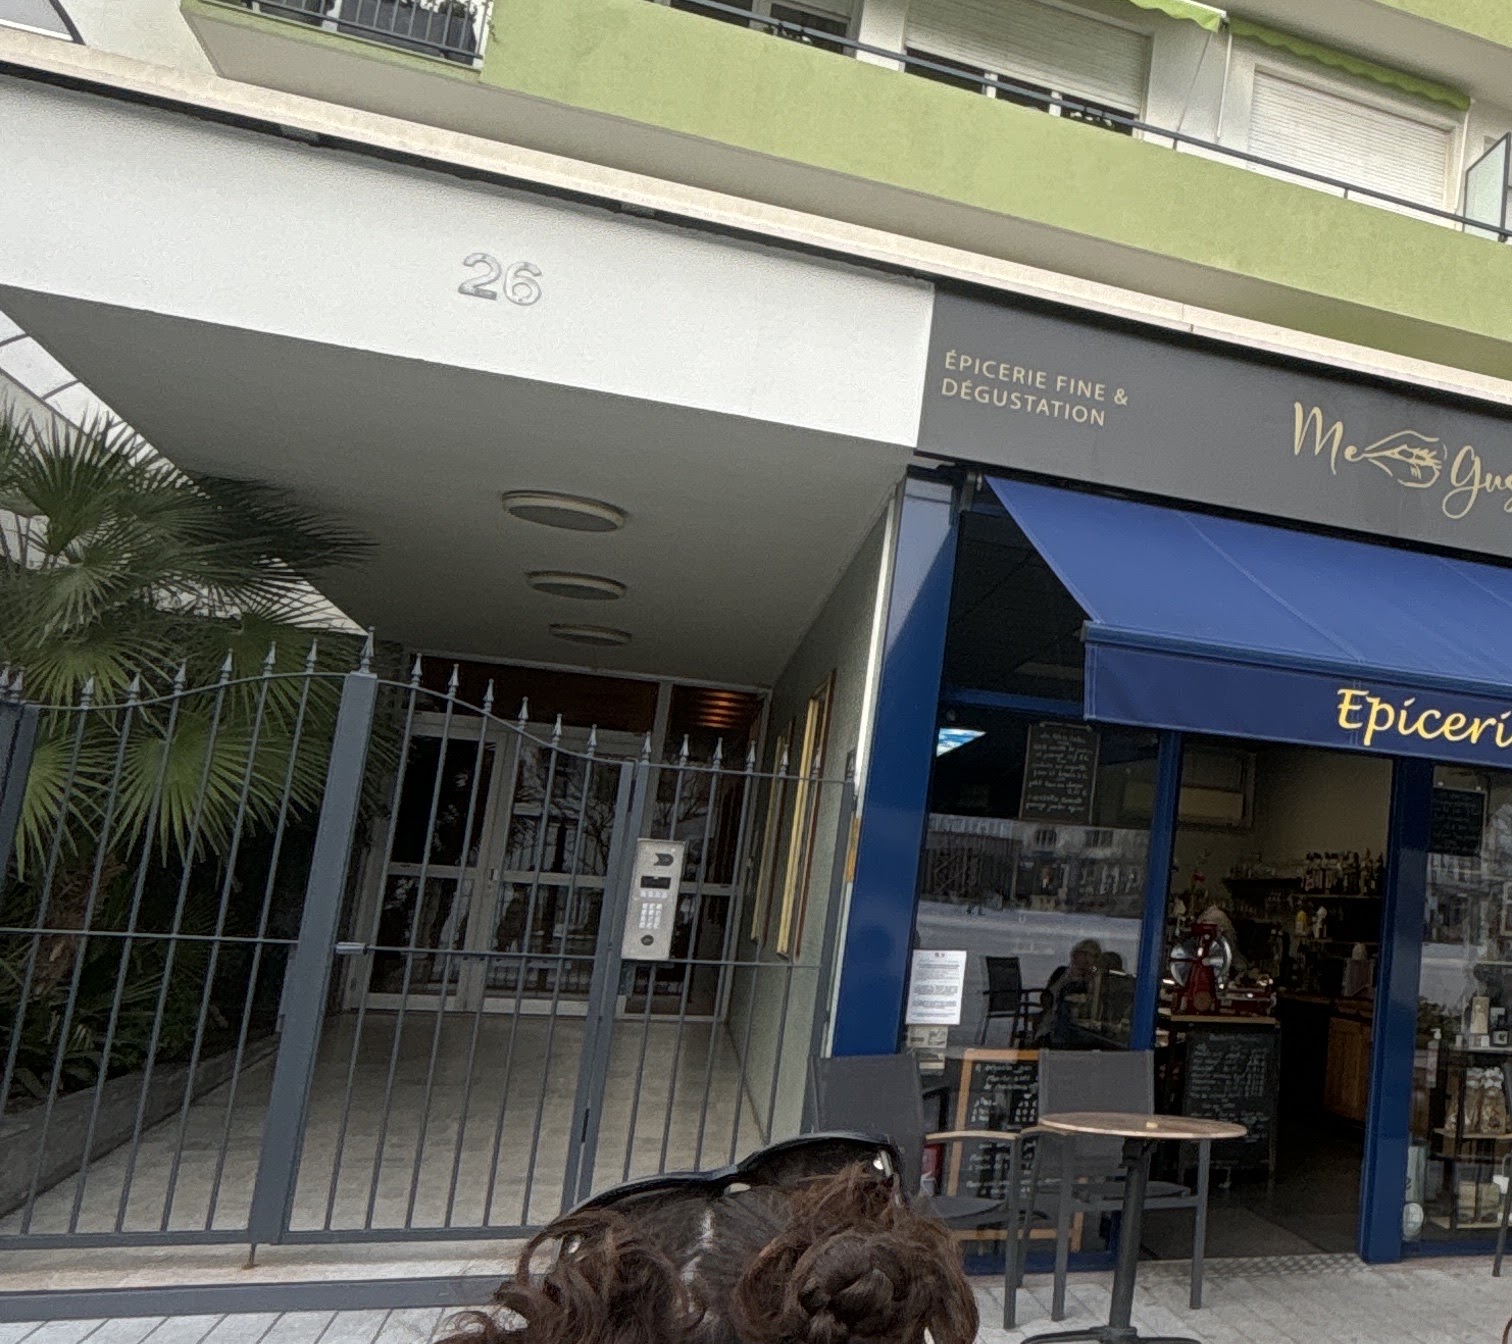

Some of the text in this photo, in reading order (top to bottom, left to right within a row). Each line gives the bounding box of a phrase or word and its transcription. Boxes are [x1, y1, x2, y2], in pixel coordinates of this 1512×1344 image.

[457, 252, 543, 306] 26
[941, 377, 1106, 426] DÉGUSTATION
[945, 350, 1128, 406] ÉPICERIE FINE &
